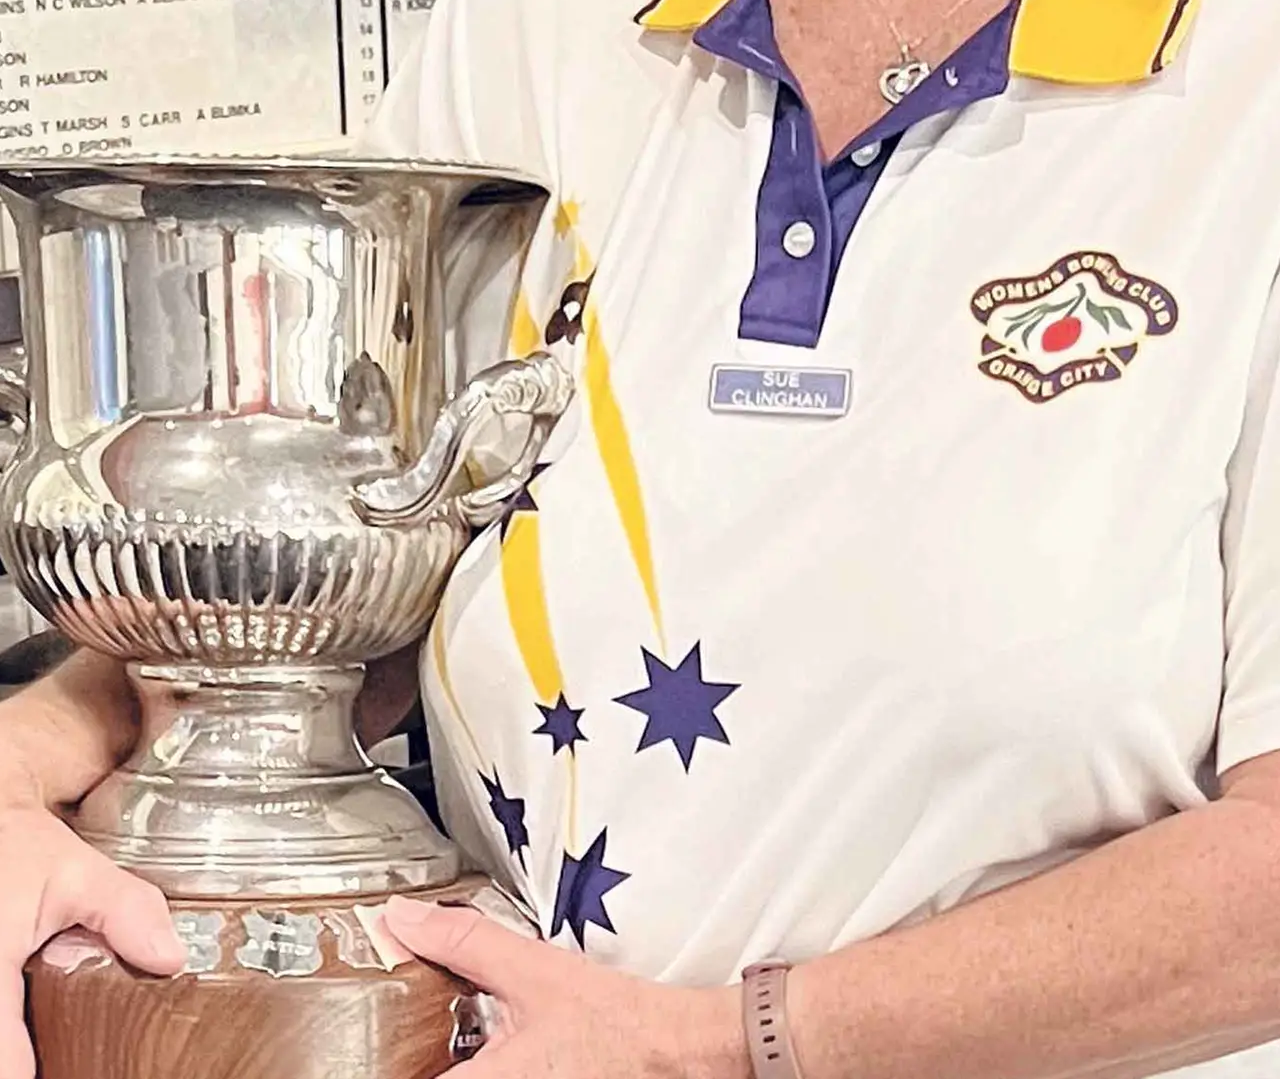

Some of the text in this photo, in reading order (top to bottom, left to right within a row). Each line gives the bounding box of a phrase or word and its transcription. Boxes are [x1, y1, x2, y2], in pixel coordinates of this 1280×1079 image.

[973, 270, 1064, 312] WOMENS
[1127, 281, 1172, 327] CLUB
[763, 371, 801, 388] SUE
[1060, 361, 1108, 388] CITY
[731, 389, 828, 409] CLINGHAN
